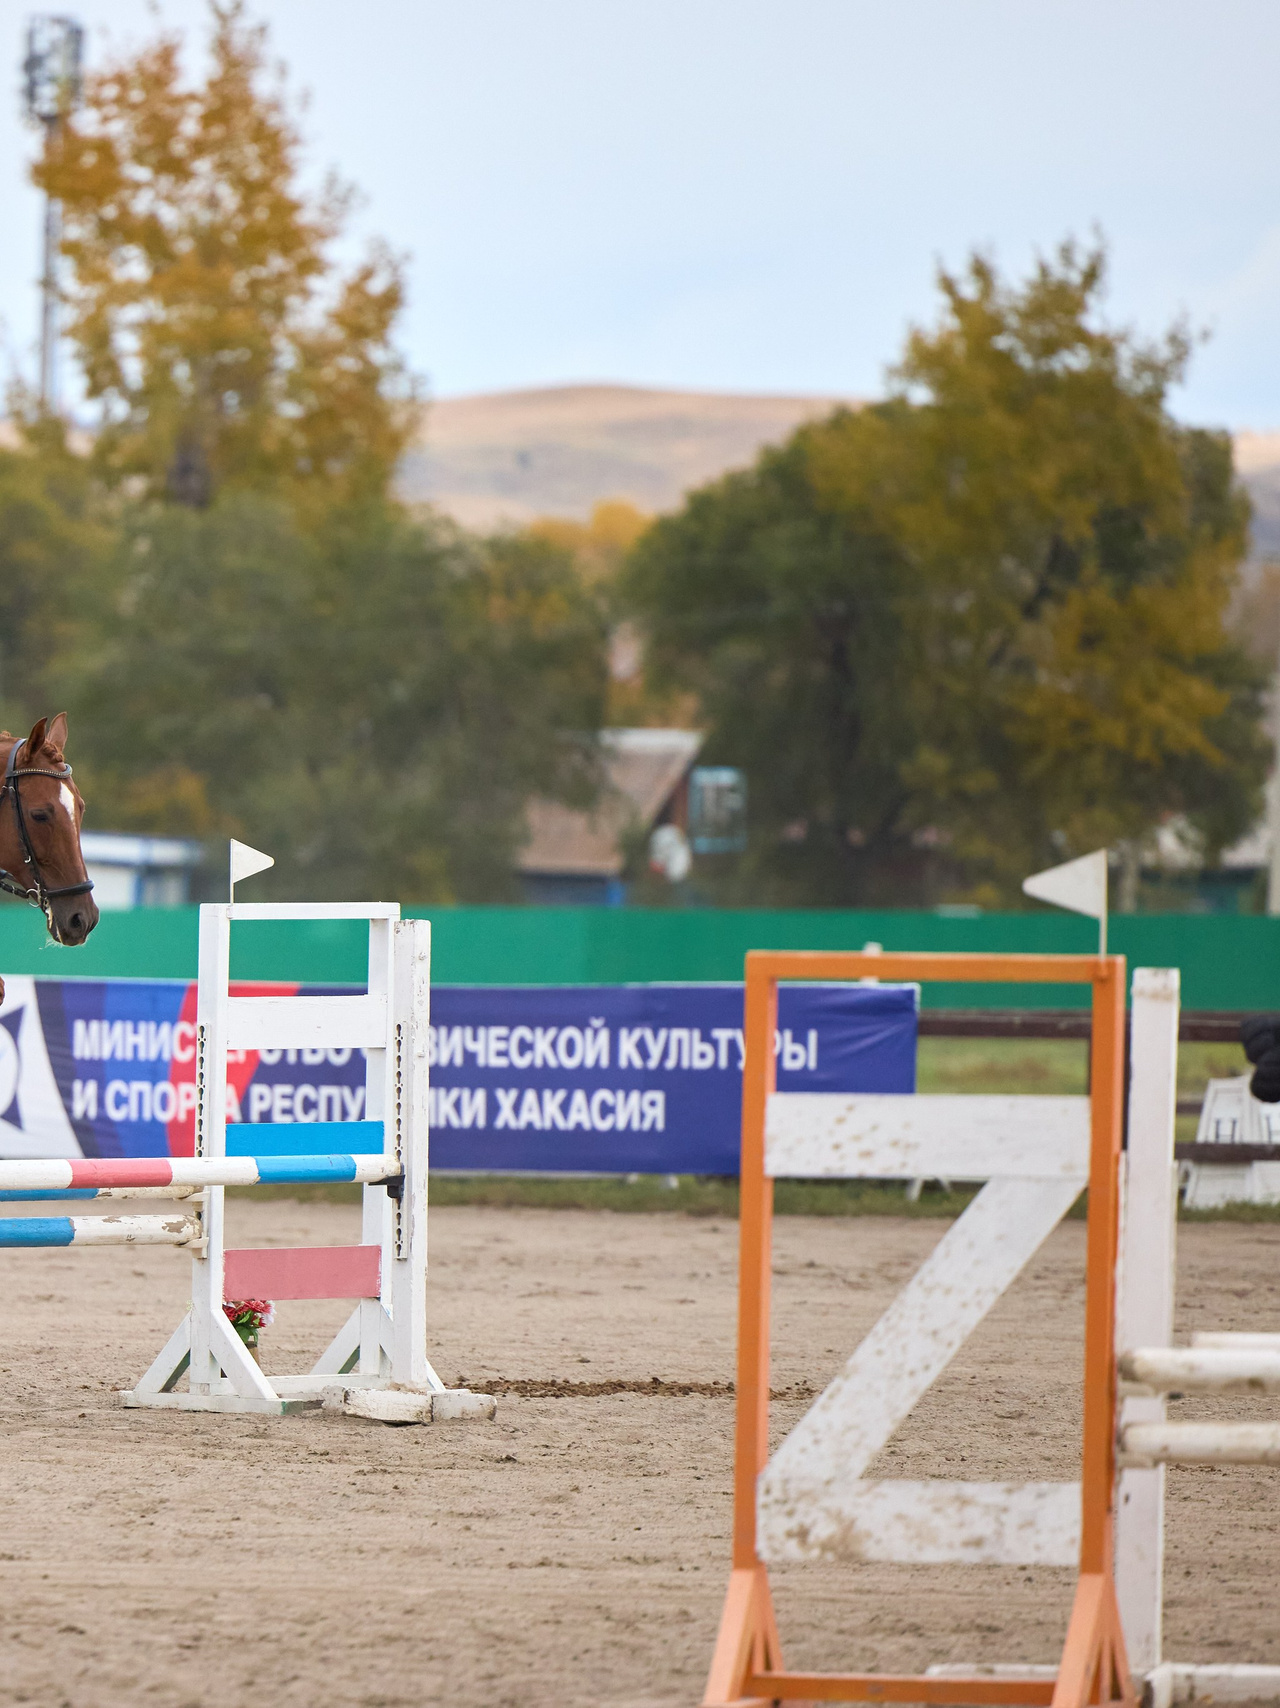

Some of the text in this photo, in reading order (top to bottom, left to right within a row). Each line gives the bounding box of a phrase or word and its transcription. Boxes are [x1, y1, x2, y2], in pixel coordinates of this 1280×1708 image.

[72, 1079, 666, 1132] И СПОРА РЕСПУКИ ХАКАСИЯ
